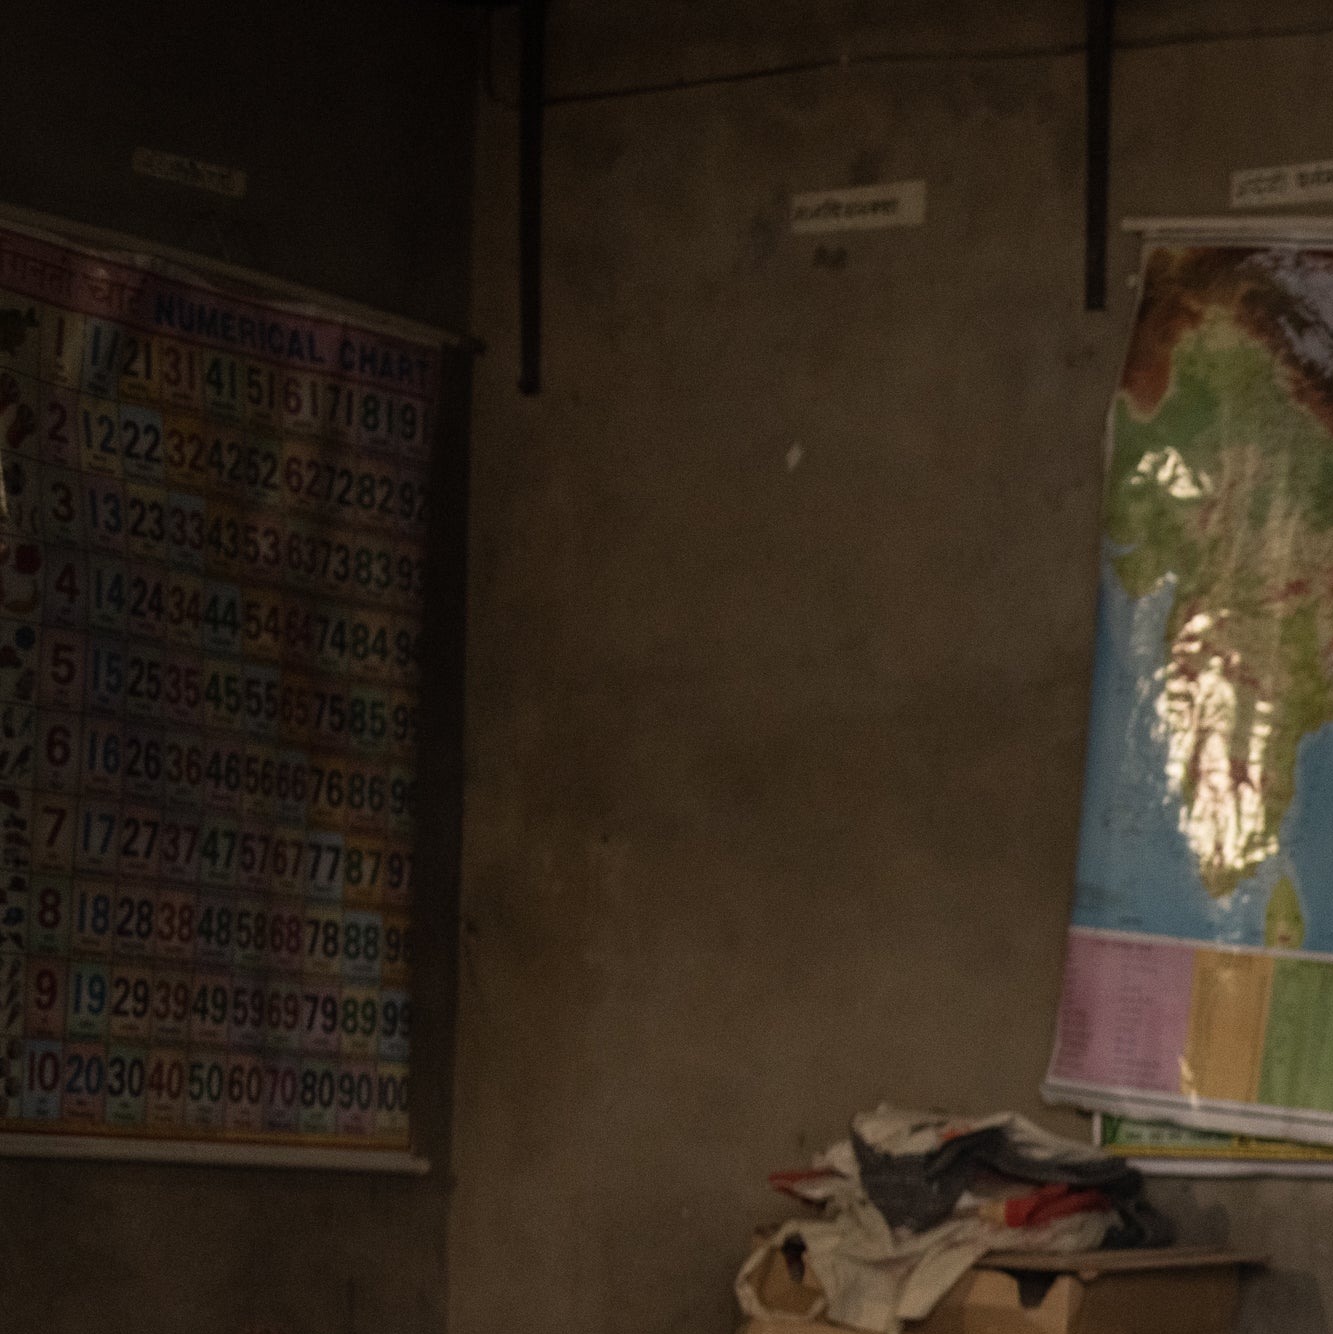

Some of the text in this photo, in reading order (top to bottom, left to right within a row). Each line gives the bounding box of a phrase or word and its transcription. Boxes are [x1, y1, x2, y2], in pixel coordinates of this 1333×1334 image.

[57, 317, 65, 356] 1
[92, 326, 120, 370] 11
[123, 336, 152, 380] 21
[164, 346, 196, 390] 31
[206, 356, 236, 399] 41
[247, 366, 275, 409] 51
[284, 376, 318, 416] 61
[327, 384, 353, 425] 71
[362, 394, 394, 433] 81
[154, 291, 430, 386] NUMERICAL CHART
[48, 402, 69, 443] 2
[83, 410, 117, 454] 12
[122, 419, 162, 463] 22
[167, 427, 205, 472] 32
[208, 438, 243, 482] 42
[247, 447, 279, 490] 52
[285, 456, 321, 497] 62
[325, 465, 354, 506] 72
[357, 473, 395, 515] 82
[51, 481, 75, 523] 3
[89, 488, 122, 533] 13
[130, 497, 166, 542] 23
[171, 507, 205, 550] 33
[207, 513, 240, 560] 43
[243, 524, 281, 566] 53
[287, 531, 317, 575] 63
[320, 538, 350, 583] 73
[354, 546, 391, 589] 83
[54, 562, 80, 604] 4
[95, 569, 125, 612] 14
[130, 576, 165, 622] 24
[169, 586, 203, 629] 34
[204, 594, 241, 636] 44
[243, 601, 280, 642] 54
[317, 614, 347, 658] 74
[351, 622, 390, 661] 84
[51, 642, 76, 686] 5
[92, 649, 123, 694] 15
[127, 656, 162, 702] 25
[165, 663, 201, 709] 35
[204, 672, 241, 715] 45
[245, 678, 278, 720] 55
[313, 691, 347, 734] 75
[350, 697, 386, 739] 85
[46, 724, 72, 767] 6
[88, 732, 121, 774] 16
[126, 736, 162, 781] 26
[166, 743, 202, 786] 36
[204, 751, 241, 792] 46
[244, 756, 275, 797] 56
[276, 761, 306, 802] 66
[310, 766, 344, 809] 76
[349, 771, 385, 812] 86
[42, 805, 67, 848] 7
[83, 811, 116, 855] 17
[121, 817, 160, 860] 27
[162, 822, 200, 865] 37
[200, 828, 237, 869] 47
[240, 832, 270, 874] 57
[272, 839, 304, 878] 67
[308, 842, 342, 881] 77
[345, 847, 382, 886] 87
[37, 887, 62, 930] 8
[78, 891, 110, 935] 18
[116, 896, 154, 939] 28
[157, 901, 195, 943] 38
[197, 906, 232, 947] 48
[236, 910, 267, 951] 58
[270, 913, 302, 955] 68
[306, 919, 339, 958] 78
[343, 923, 380, 962] 88
[35, 968, 58, 1011] 9
[74, 971, 106, 1015] 19
[112, 976, 150, 1018] 29
[154, 980, 190, 1022] 39
[191, 984, 228, 1025] 49
[233, 987, 265, 1028] 59
[267, 991, 299, 1030] 69
[303, 994, 338, 1034] 79
[342, 998, 377, 1036] 89
[27, 1051, 410, 1111] 10 20 30 40 50 60 70 80 90 100
